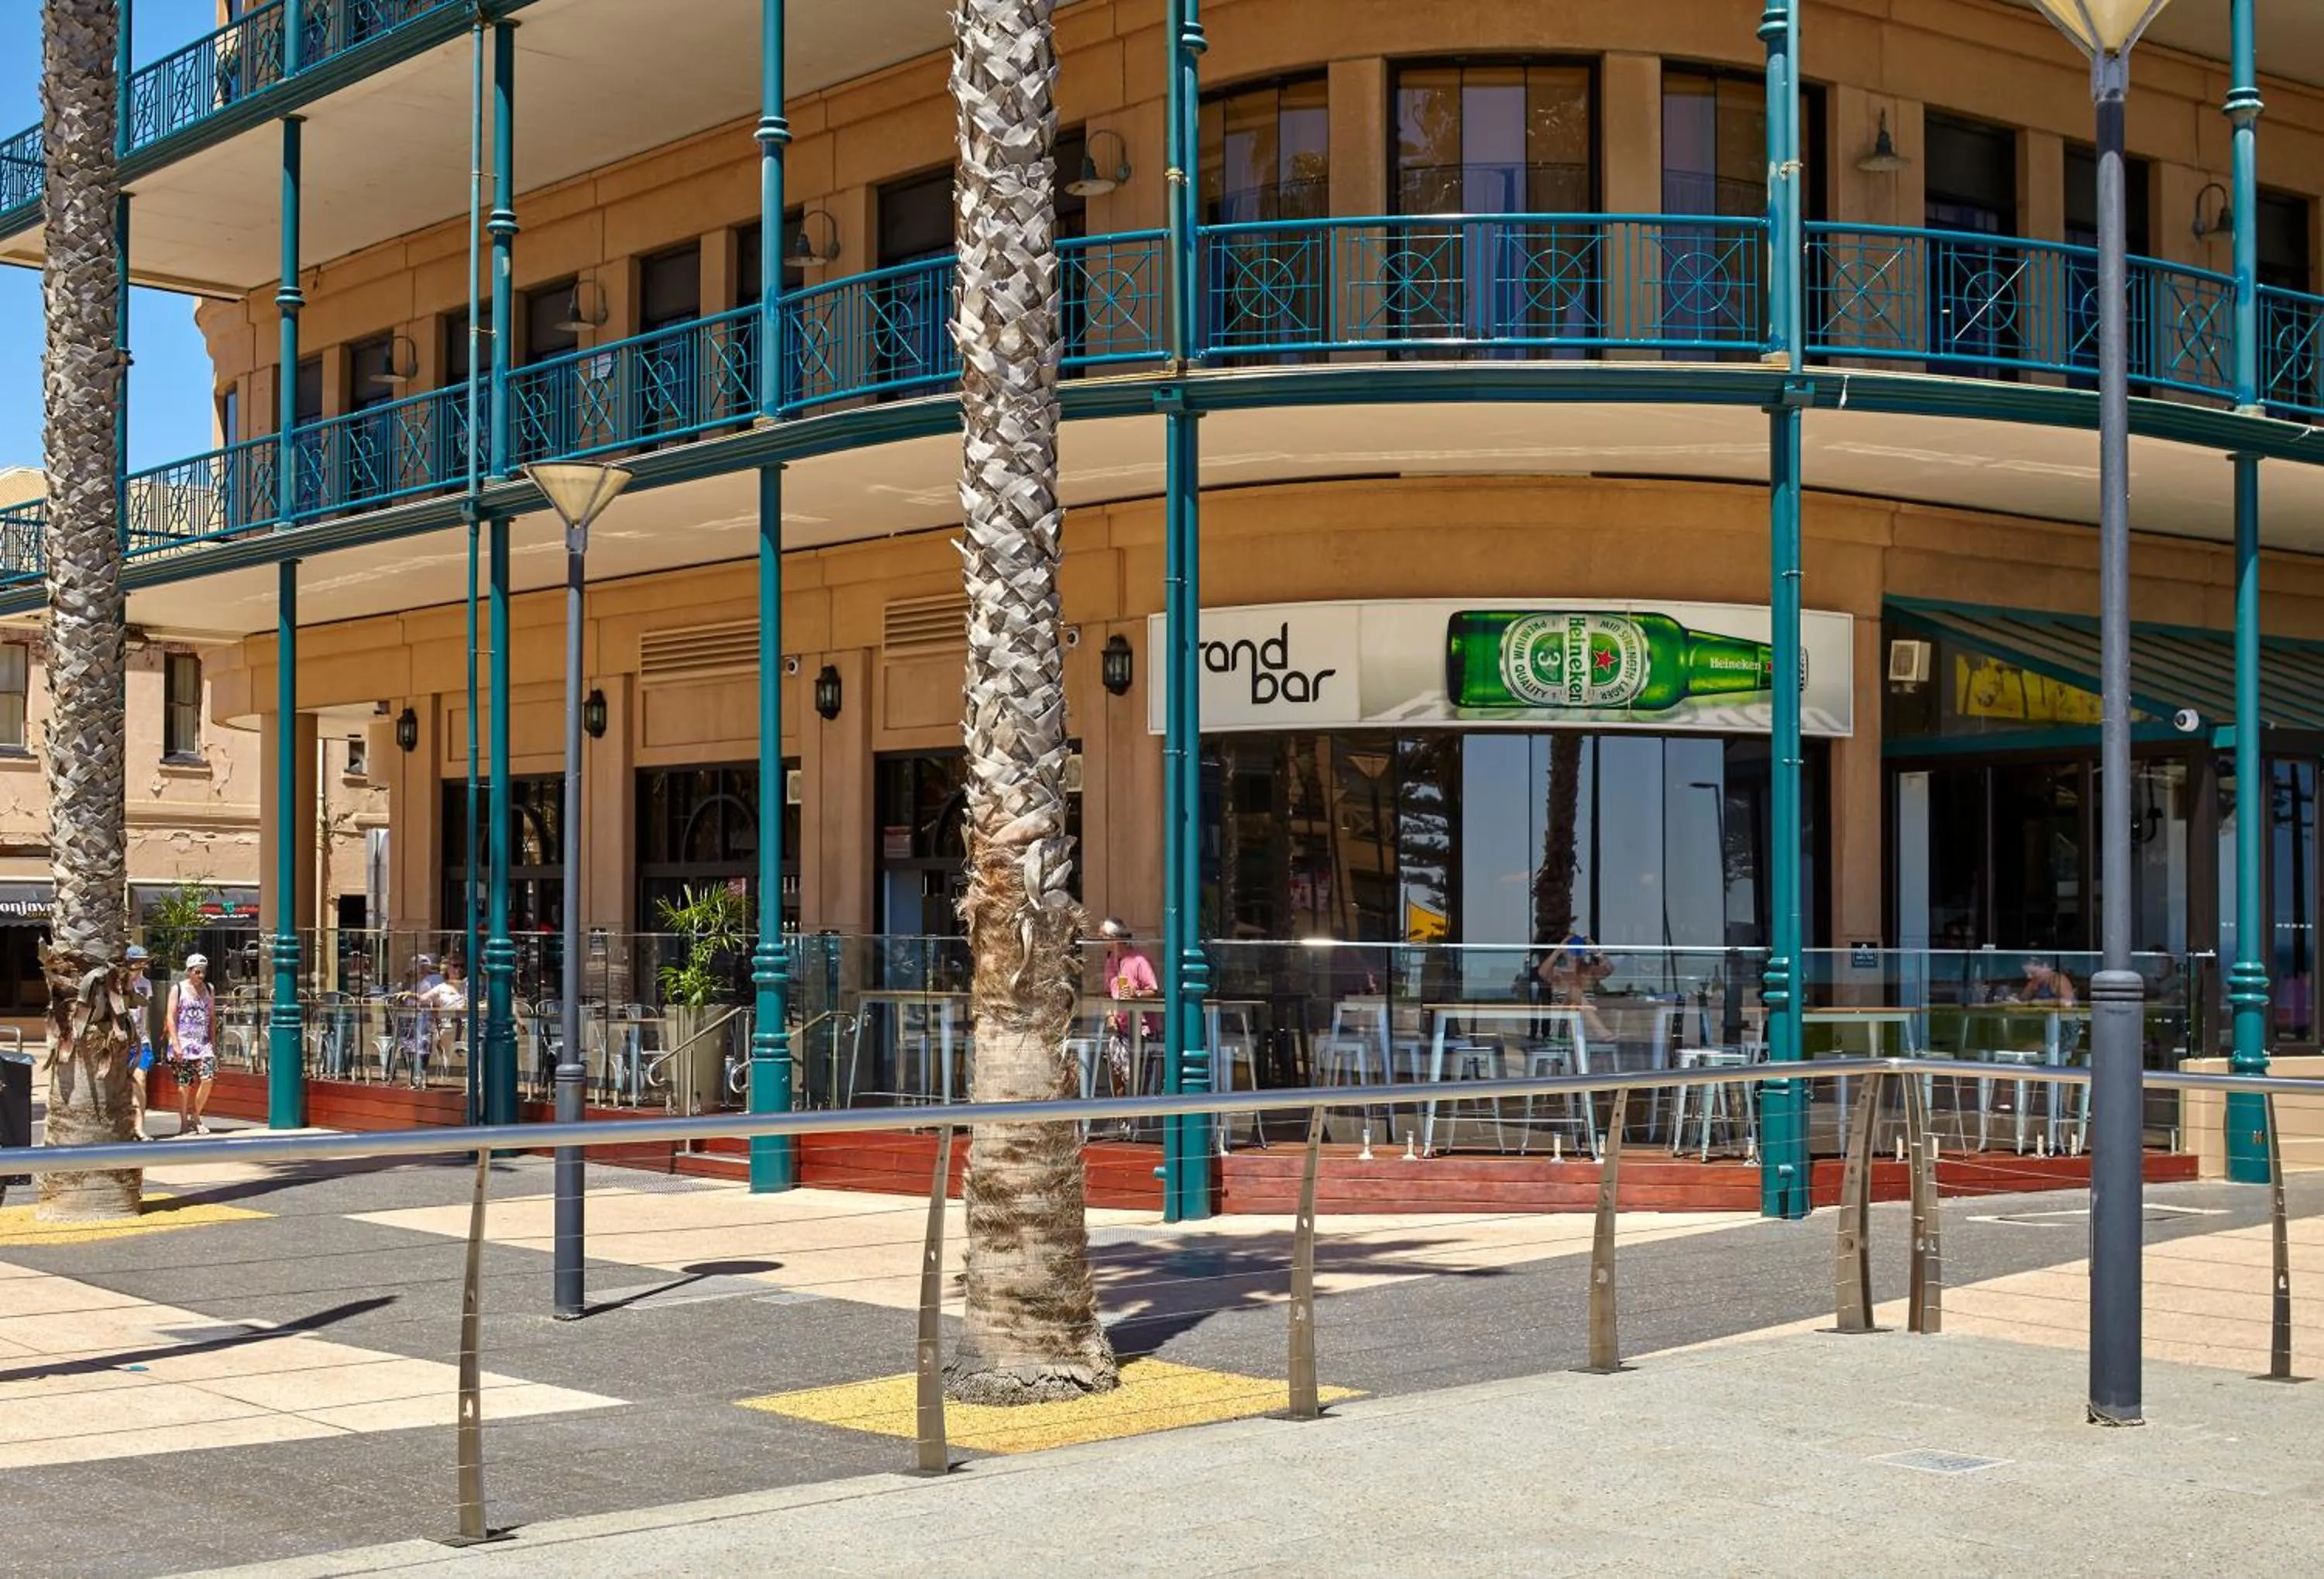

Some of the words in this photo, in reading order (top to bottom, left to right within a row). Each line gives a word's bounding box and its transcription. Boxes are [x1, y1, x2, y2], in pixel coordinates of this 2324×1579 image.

[1513, 621, 1547, 660] PREMIUM
[1538, 652, 1561, 666] 3
[1569, 617, 1587, 703] Heineken
[1710, 656, 1761, 669] Heineken
[1251, 657, 1336, 704] bar
[1514, 664, 1549, 699] QUALITY
